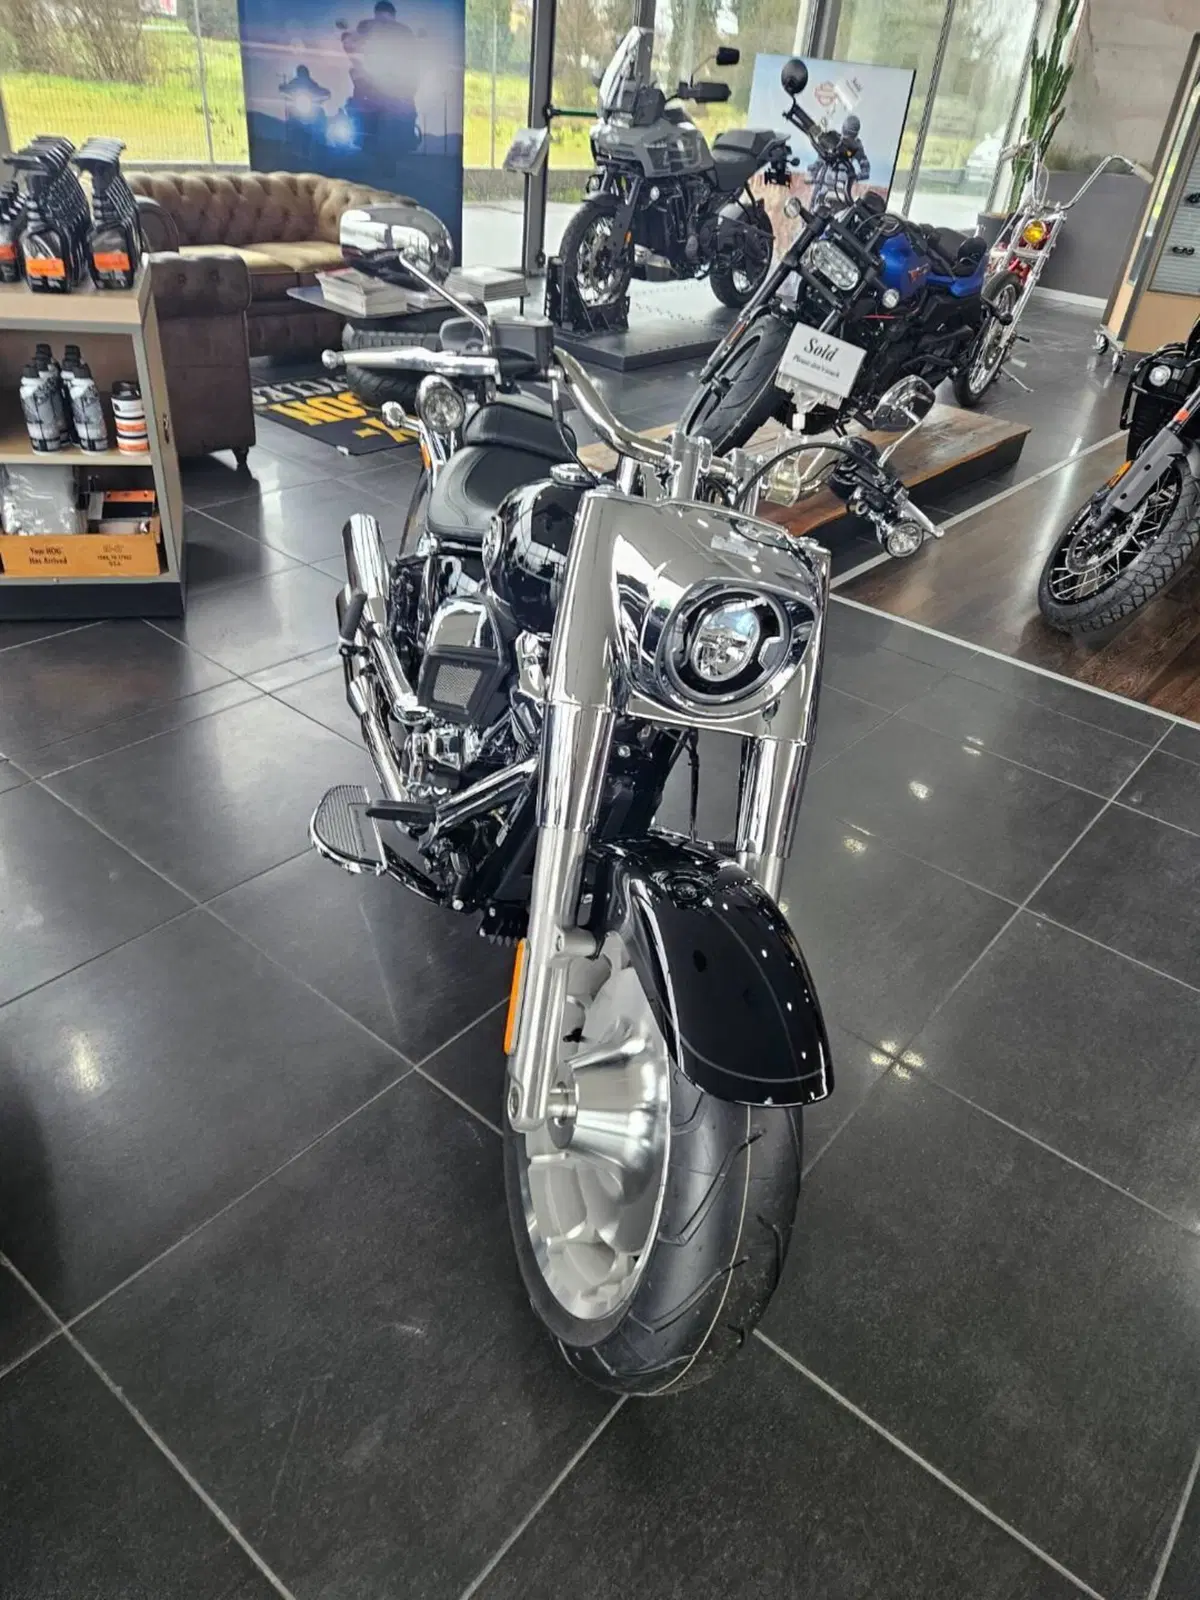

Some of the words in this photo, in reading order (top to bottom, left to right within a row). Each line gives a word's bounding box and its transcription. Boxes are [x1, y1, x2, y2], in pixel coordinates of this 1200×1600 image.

[803, 337, 839, 362] Sold
[45, 547, 62, 555] HOG
[29, 556, 41, 564] Has
[43, 556, 67, 565] Arrived
